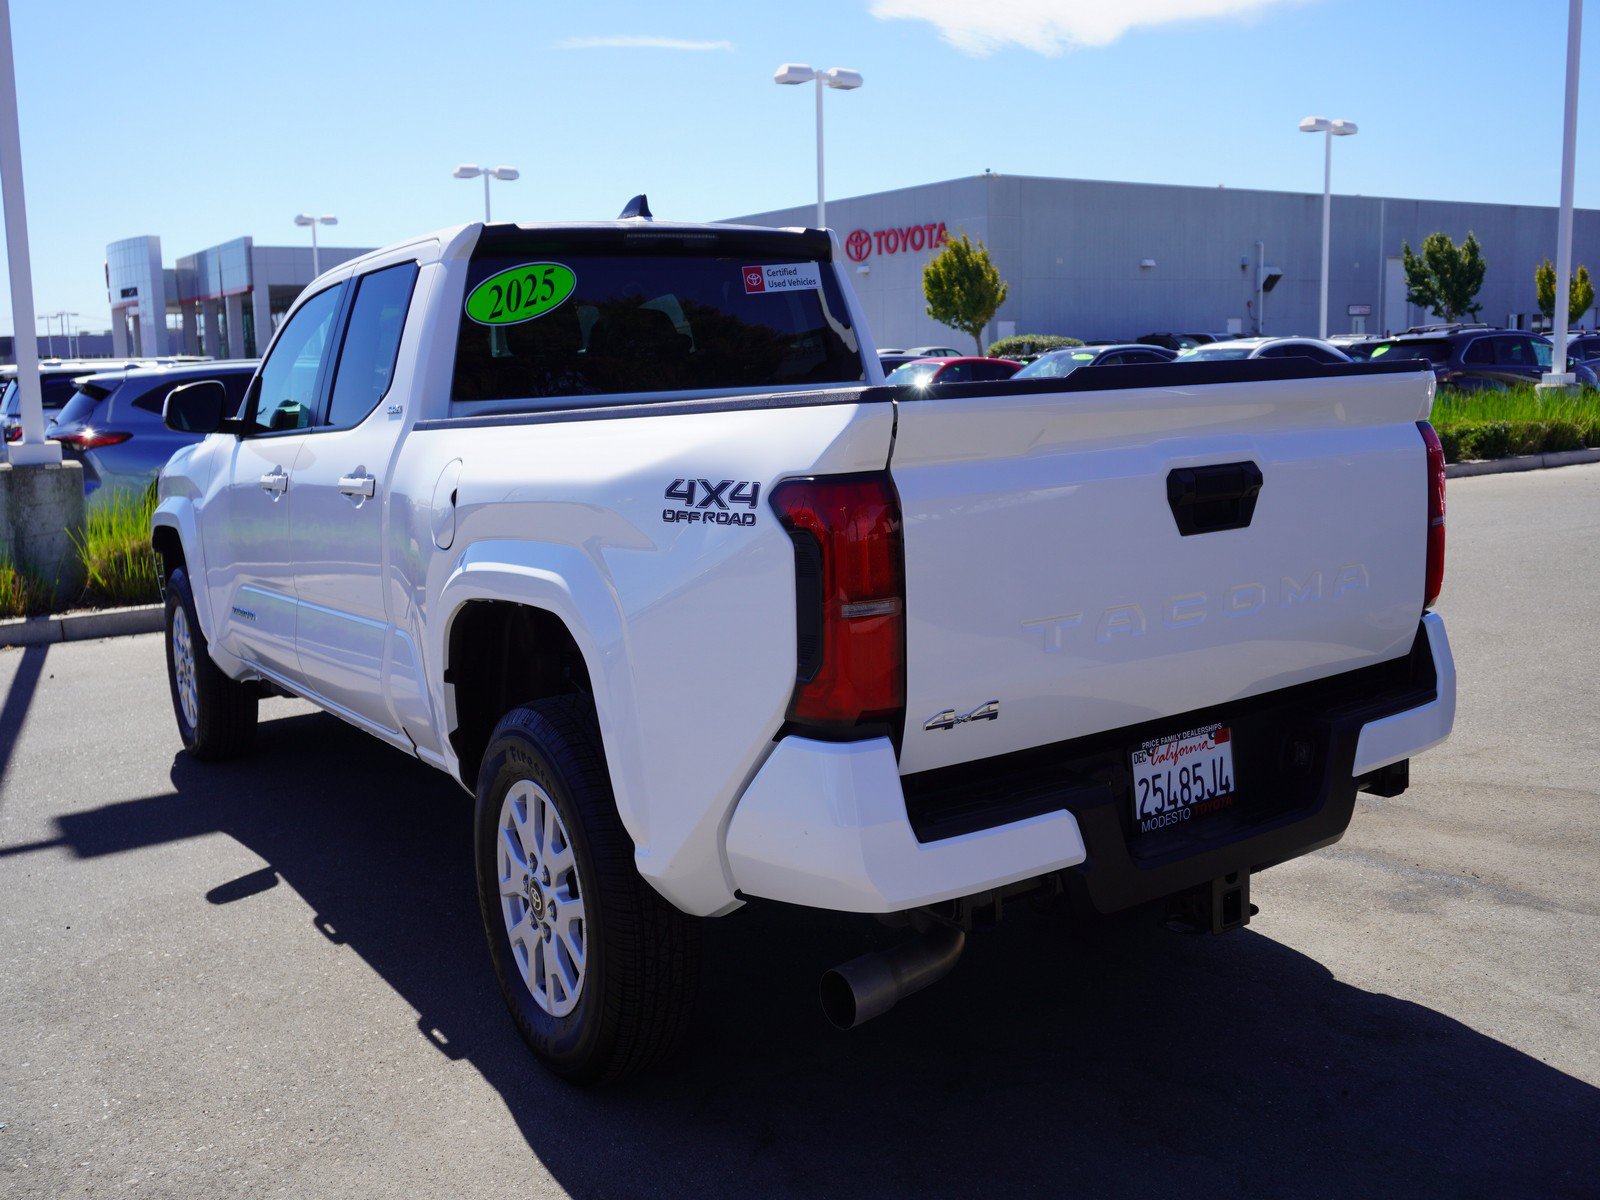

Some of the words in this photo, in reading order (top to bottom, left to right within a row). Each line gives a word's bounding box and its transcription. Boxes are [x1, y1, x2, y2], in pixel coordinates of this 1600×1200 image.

[873, 222, 948, 254] TOYOTA
[767, 267, 798, 277] Certified
[768, 279, 786, 288] Used
[789, 278, 817, 287] Vehicles
[489, 268, 555, 319] 2025
[664, 479, 761, 510] 4X4
[662, 509, 700, 524] OFF
[702, 512, 757, 526] ROAD
[1021, 563, 1369, 652] TACOMA
[1142, 740, 1159, 749] PRICE
[1160, 734, 1181, 745] FAMILY
[1182, 723, 1222, 739] DEALERSHIPS
[1134, 751, 1147, 764] DEC
[1151, 739, 1215, 766] California
[1138, 756, 1231, 817] 25485J4
[1141, 807, 1191, 833] MODESTO
[1194, 796, 1232, 816] TOYOTA
